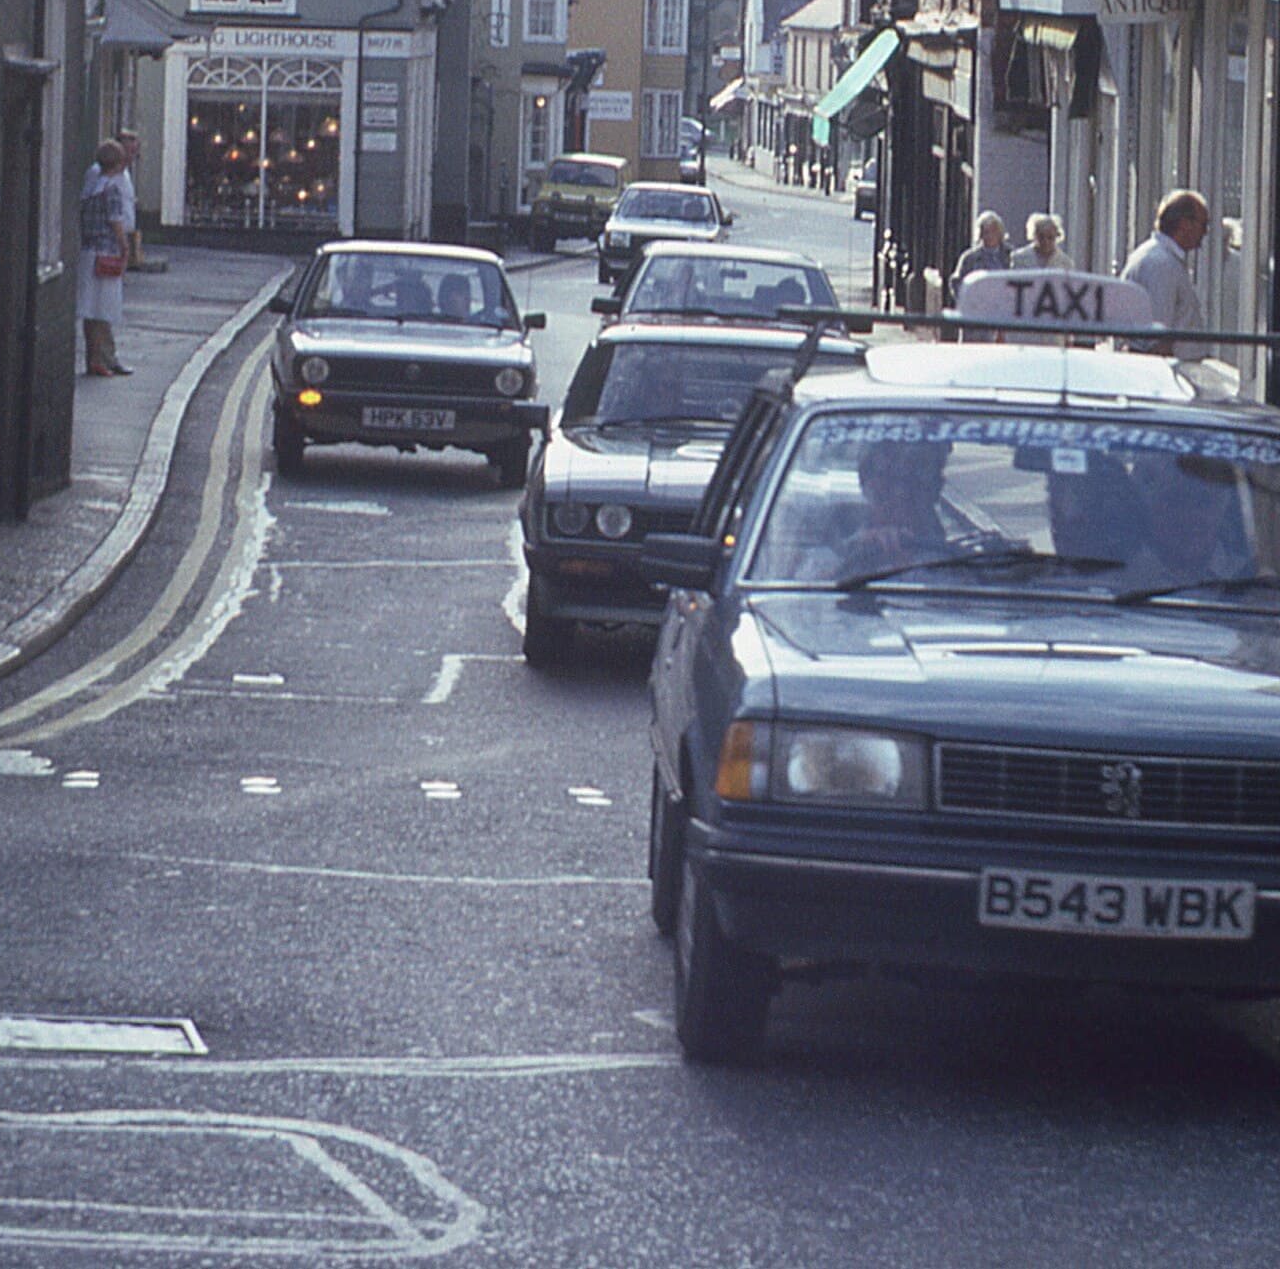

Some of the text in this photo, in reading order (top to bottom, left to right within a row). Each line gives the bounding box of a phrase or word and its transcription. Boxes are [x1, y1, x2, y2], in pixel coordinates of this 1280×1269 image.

[234, 30, 337, 50] LIGHTHOUSE
[1006, 280, 1104, 323] TAXI
[985, 874, 1244, 930] B543 WBK
